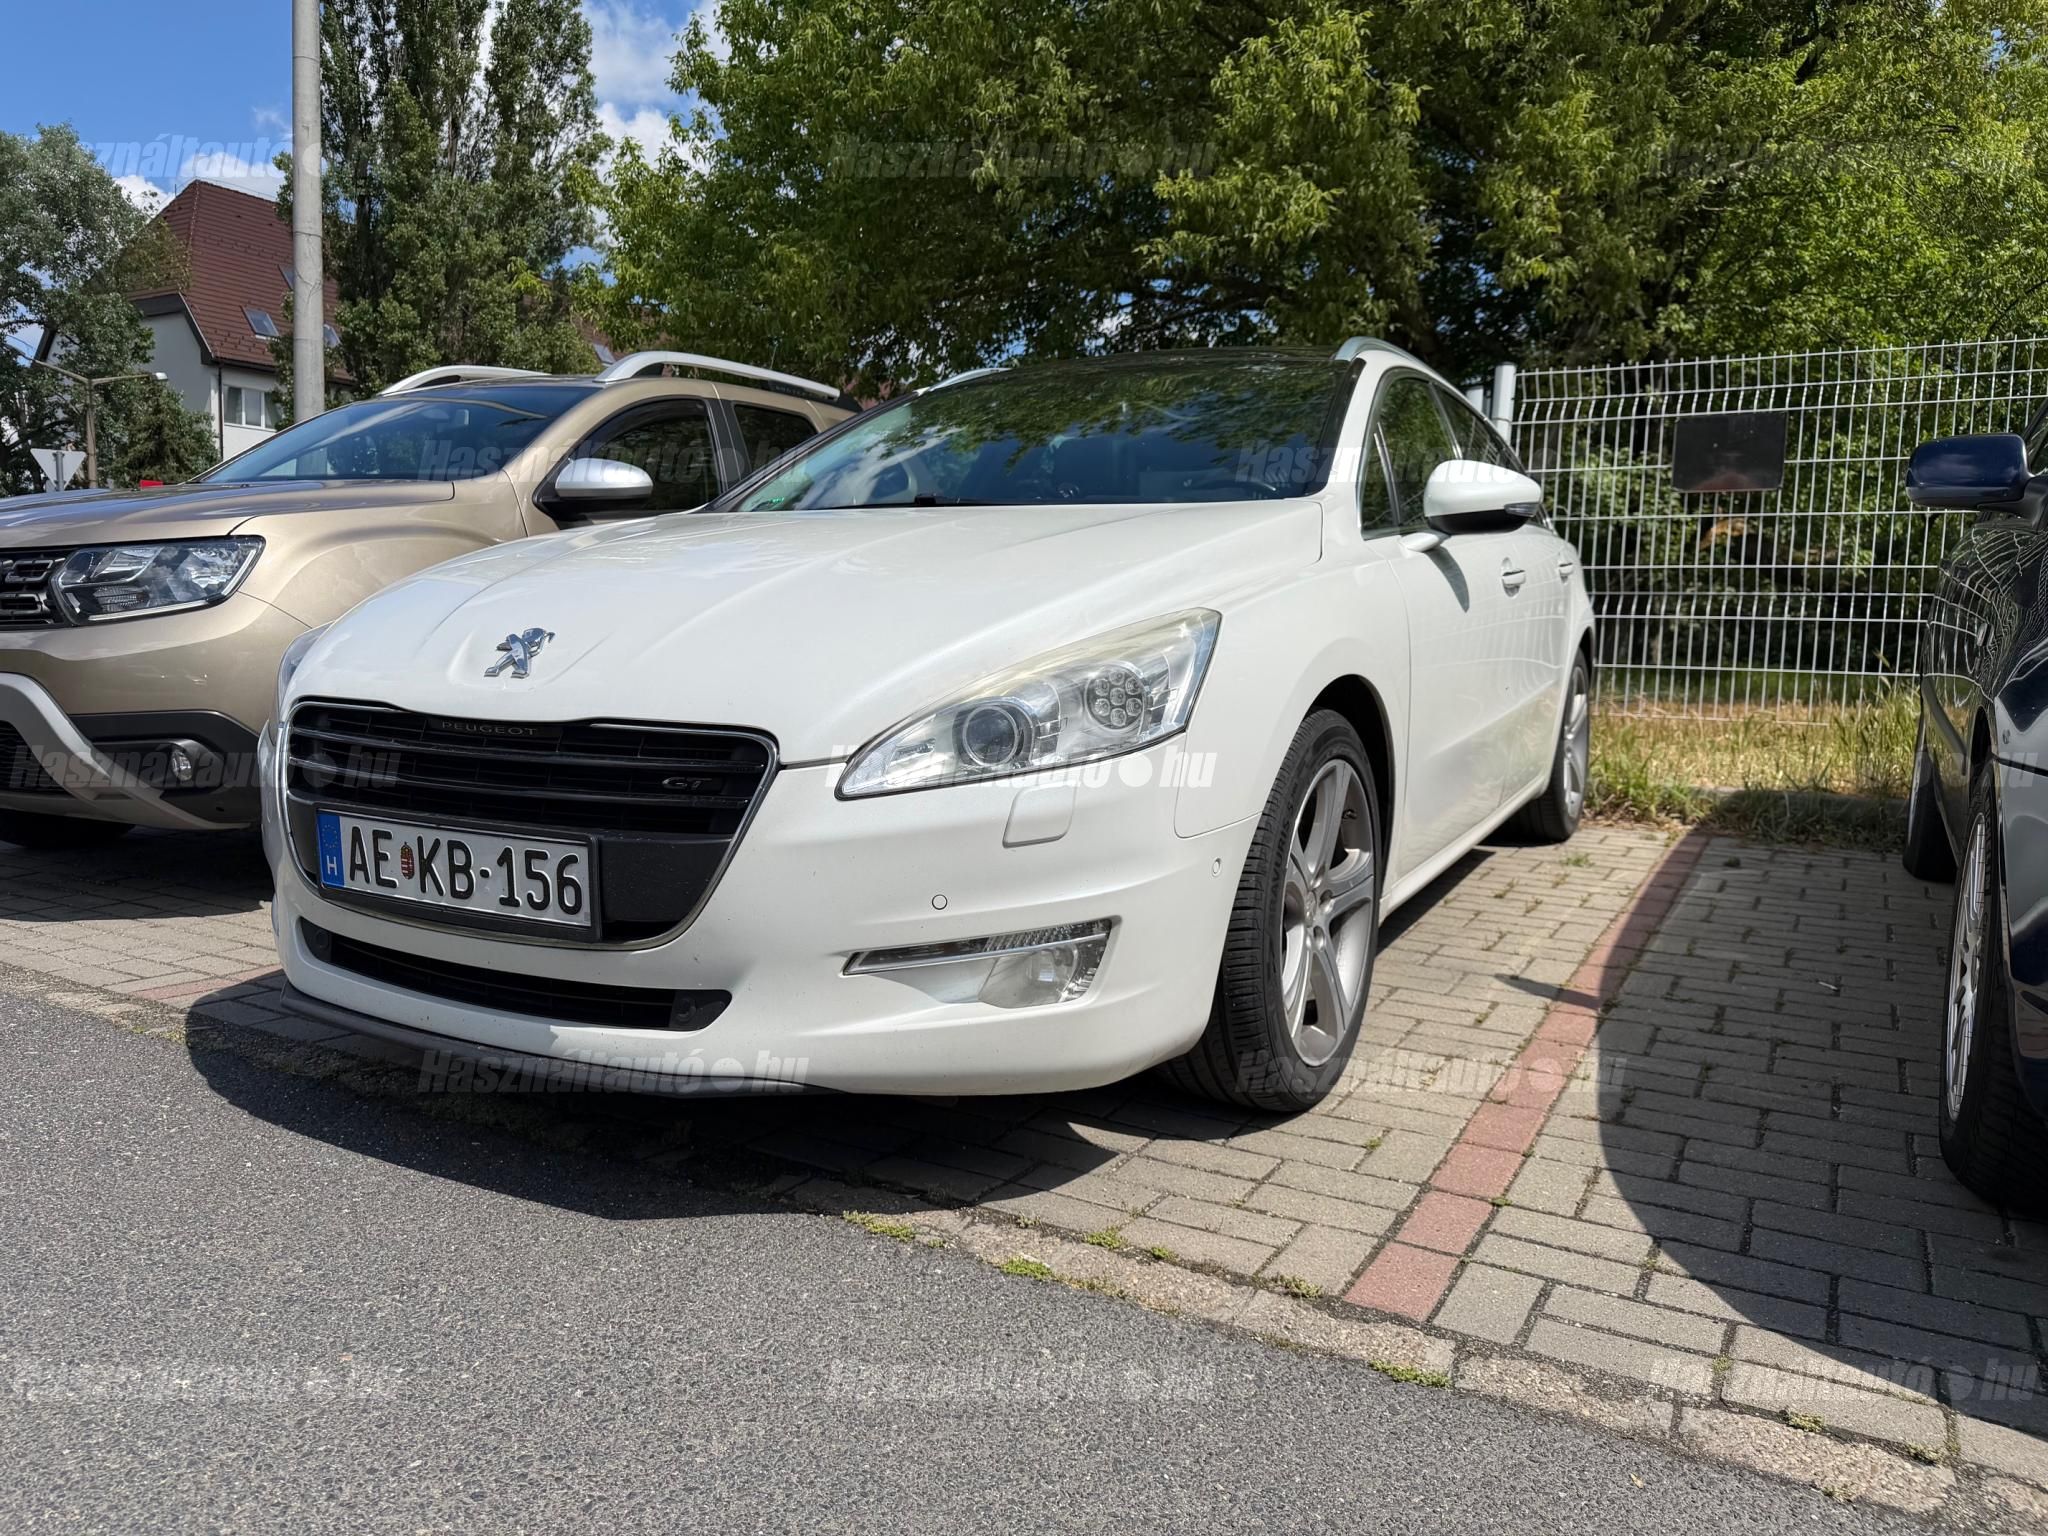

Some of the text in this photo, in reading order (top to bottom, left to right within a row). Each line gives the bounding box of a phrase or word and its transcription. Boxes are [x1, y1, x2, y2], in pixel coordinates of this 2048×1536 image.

[441, 721, 538, 736] PEUGEOT
[661, 776, 713, 791] GT
[325, 855, 338, 876] H
